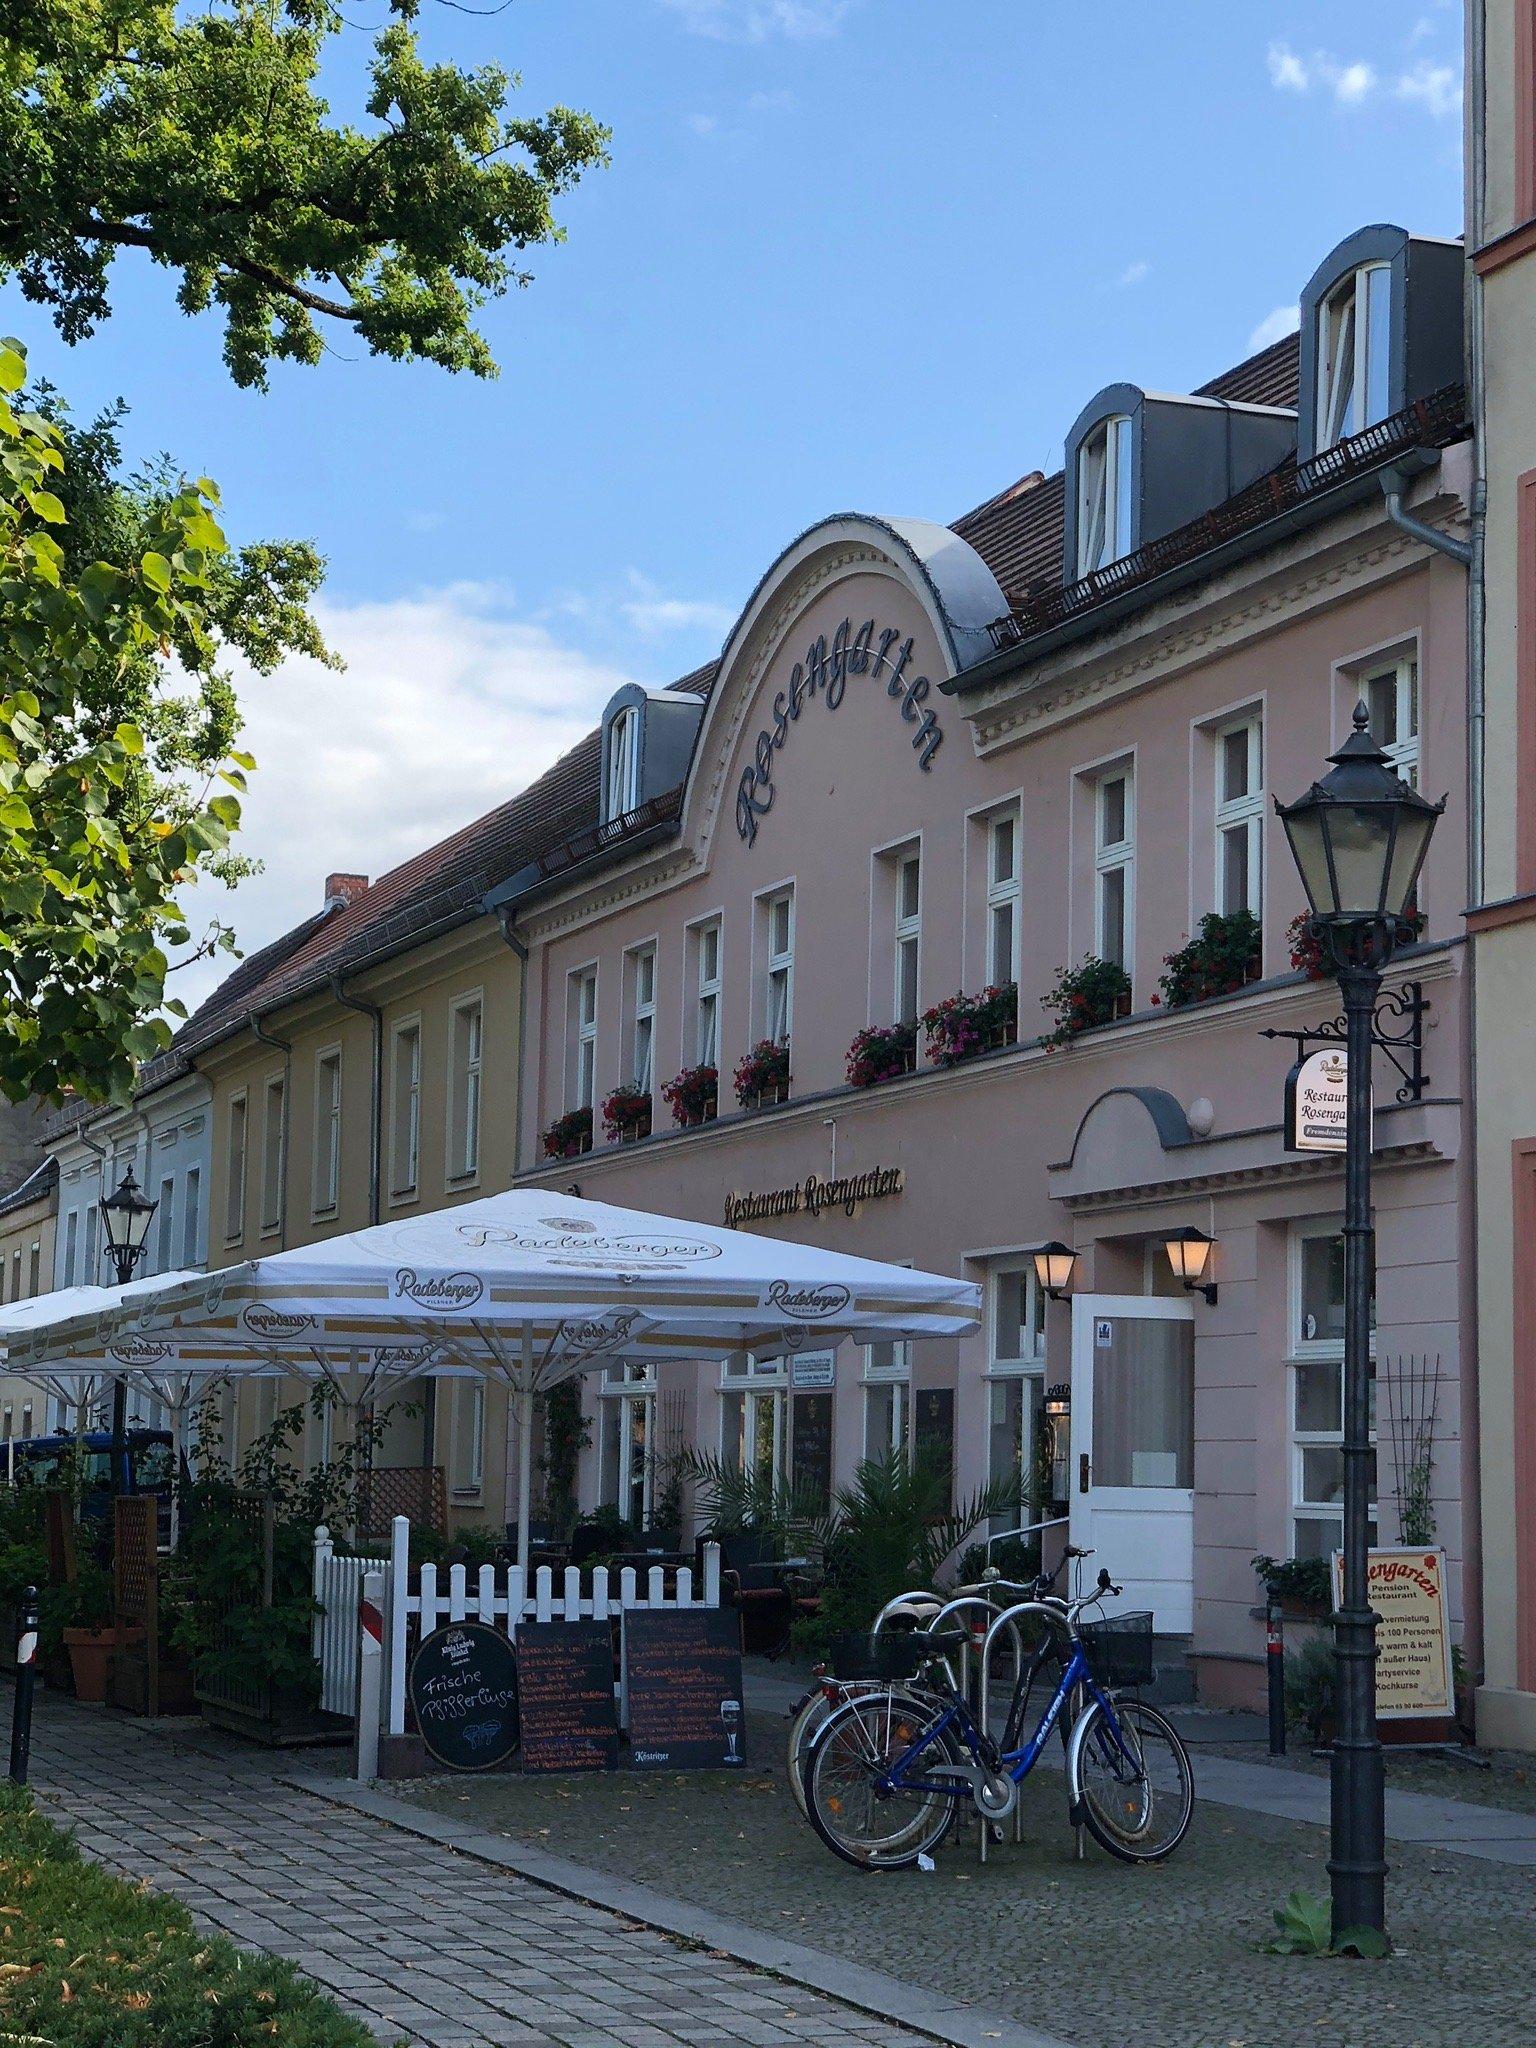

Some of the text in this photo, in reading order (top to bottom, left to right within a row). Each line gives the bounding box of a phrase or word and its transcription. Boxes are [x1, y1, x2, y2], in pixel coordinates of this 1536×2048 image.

[736, 617, 942, 849] Rosengarten
[1304, 1088, 1347, 1103] Restaur
[1301, 1105, 1346, 1123] Rosenga
[724, 1165, 903, 1230] Restaurant Rosengarten
[455, 1225, 715, 1260] Radeberger
[395, 1267, 482, 1306] Radeberger
[765, 1279, 848, 1313] Radeberger
[1368, 1562, 1439, 1598] engarten
[1371, 1584, 1410, 1592] Pension
[1383, 1615, 1430, 1623] rvermietung
[1388, 1628, 1401, 1636] 100
[1403, 1627, 1441, 1635] Personen
[1418, 1641, 1433, 1649] kalt
[1408, 1654, 1431, 1663] Haus)
[422, 1669, 482, 1695] Frische
[1376, 1669, 1421, 1678] artyservice
[421, 1687, 514, 1721] Pfifferlinge
[635, 1750, 671, 1762] Köstritzer
